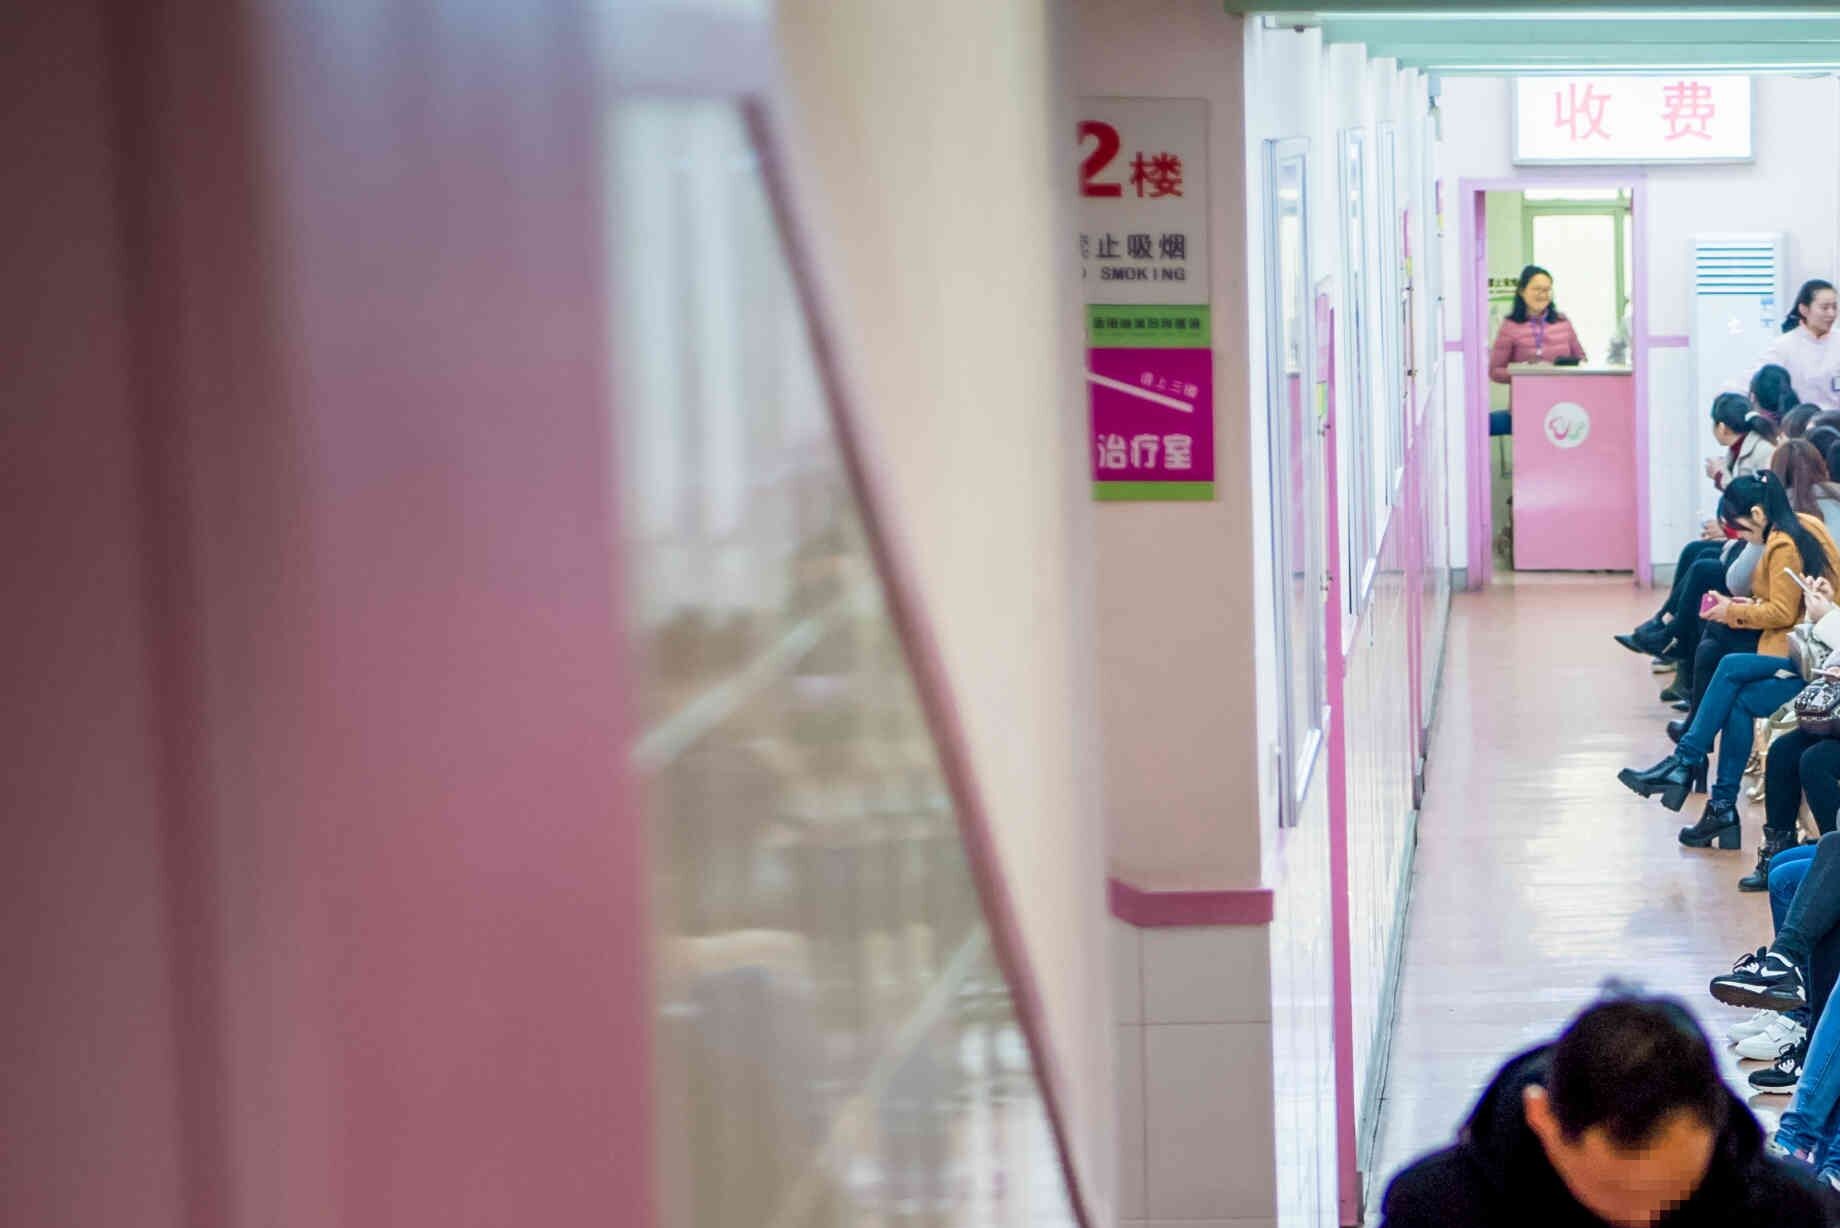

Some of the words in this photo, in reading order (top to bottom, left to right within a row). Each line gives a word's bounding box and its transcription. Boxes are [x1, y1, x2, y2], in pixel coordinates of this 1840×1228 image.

[1553, 80, 1716, 142] 收费
[1078, 119, 1184, 198] 2楼
[1101, 265, 1187, 282] SMOKING
[1096, 433, 1193, 470] 治疗室
